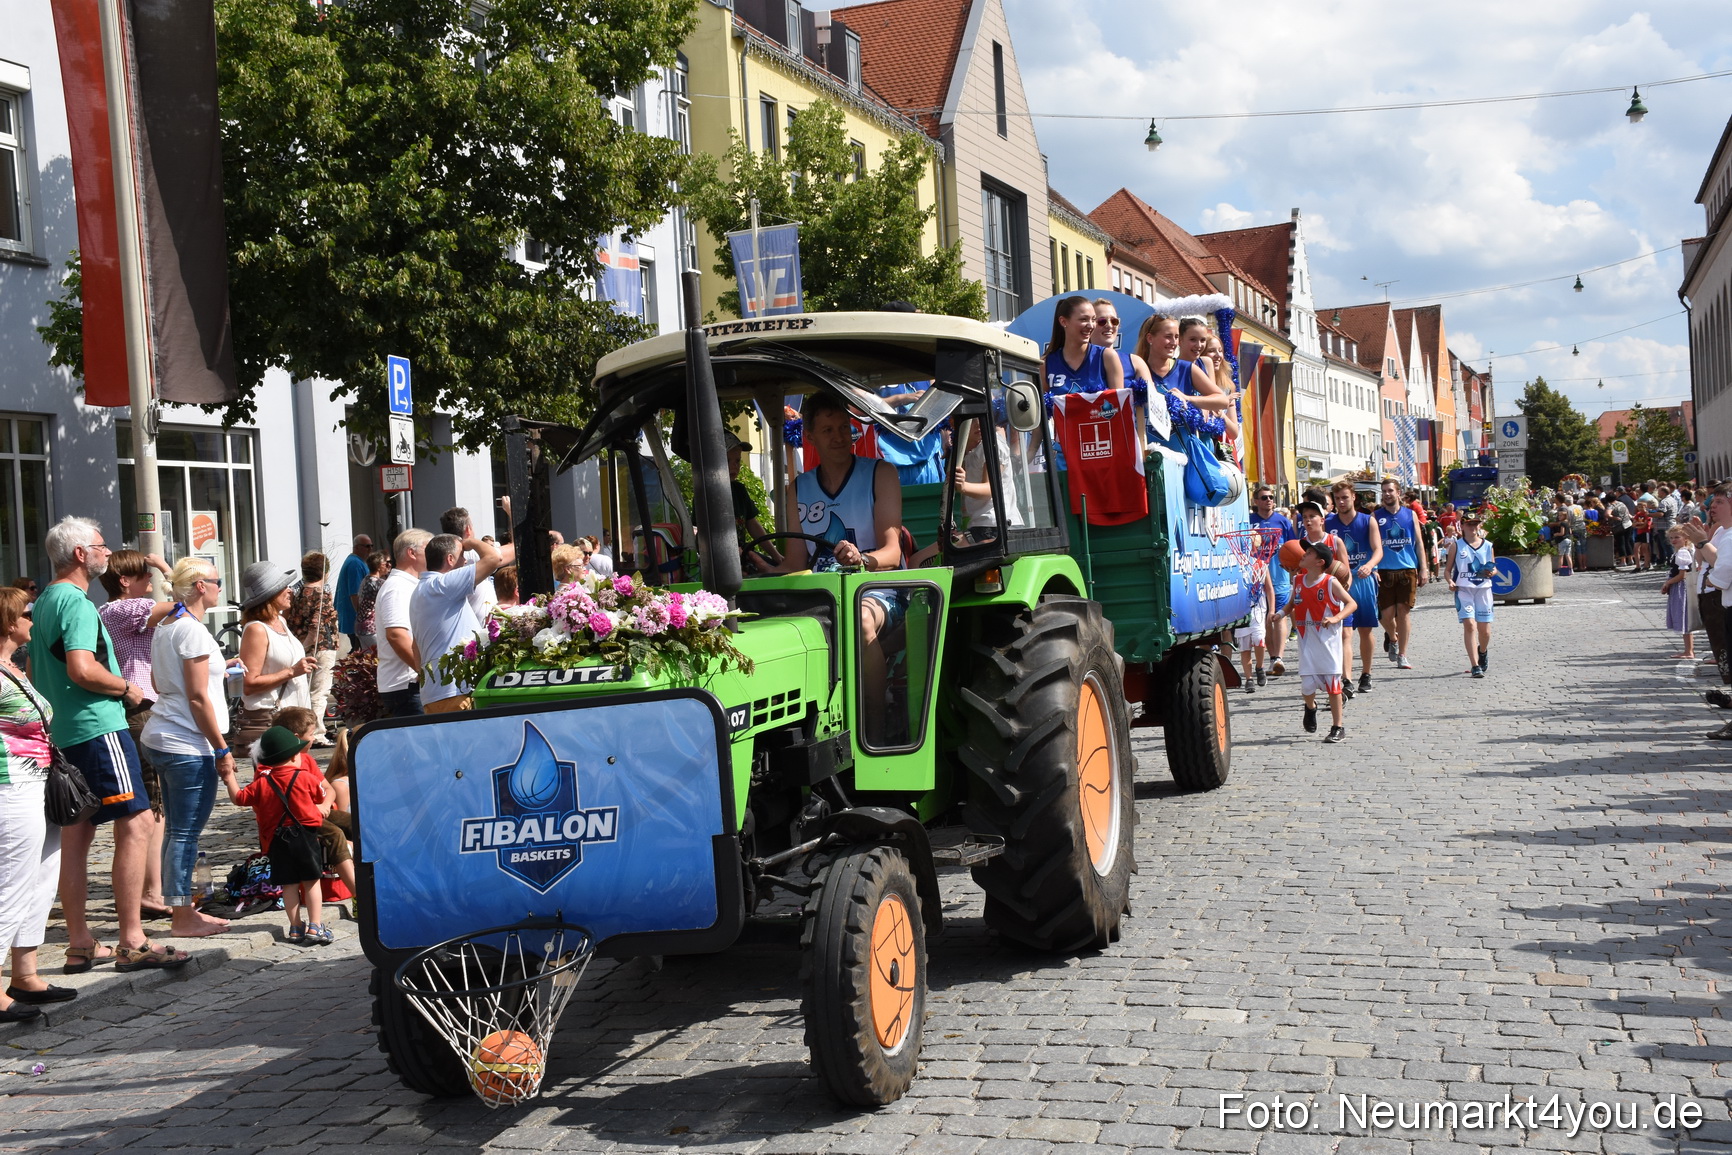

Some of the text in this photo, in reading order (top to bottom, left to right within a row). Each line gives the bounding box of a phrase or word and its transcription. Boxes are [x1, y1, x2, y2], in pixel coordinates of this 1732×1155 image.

[393, 363, 406, 406] P
[1047, 373, 1067, 388] 13
[1378, 518, 1387, 526] 9
[1317, 588, 1325, 602] 6
[494, 665, 624, 687] DEUTZ
[465, 811, 614, 848] FIBALON
[510, 848, 571, 863] BASKETS
